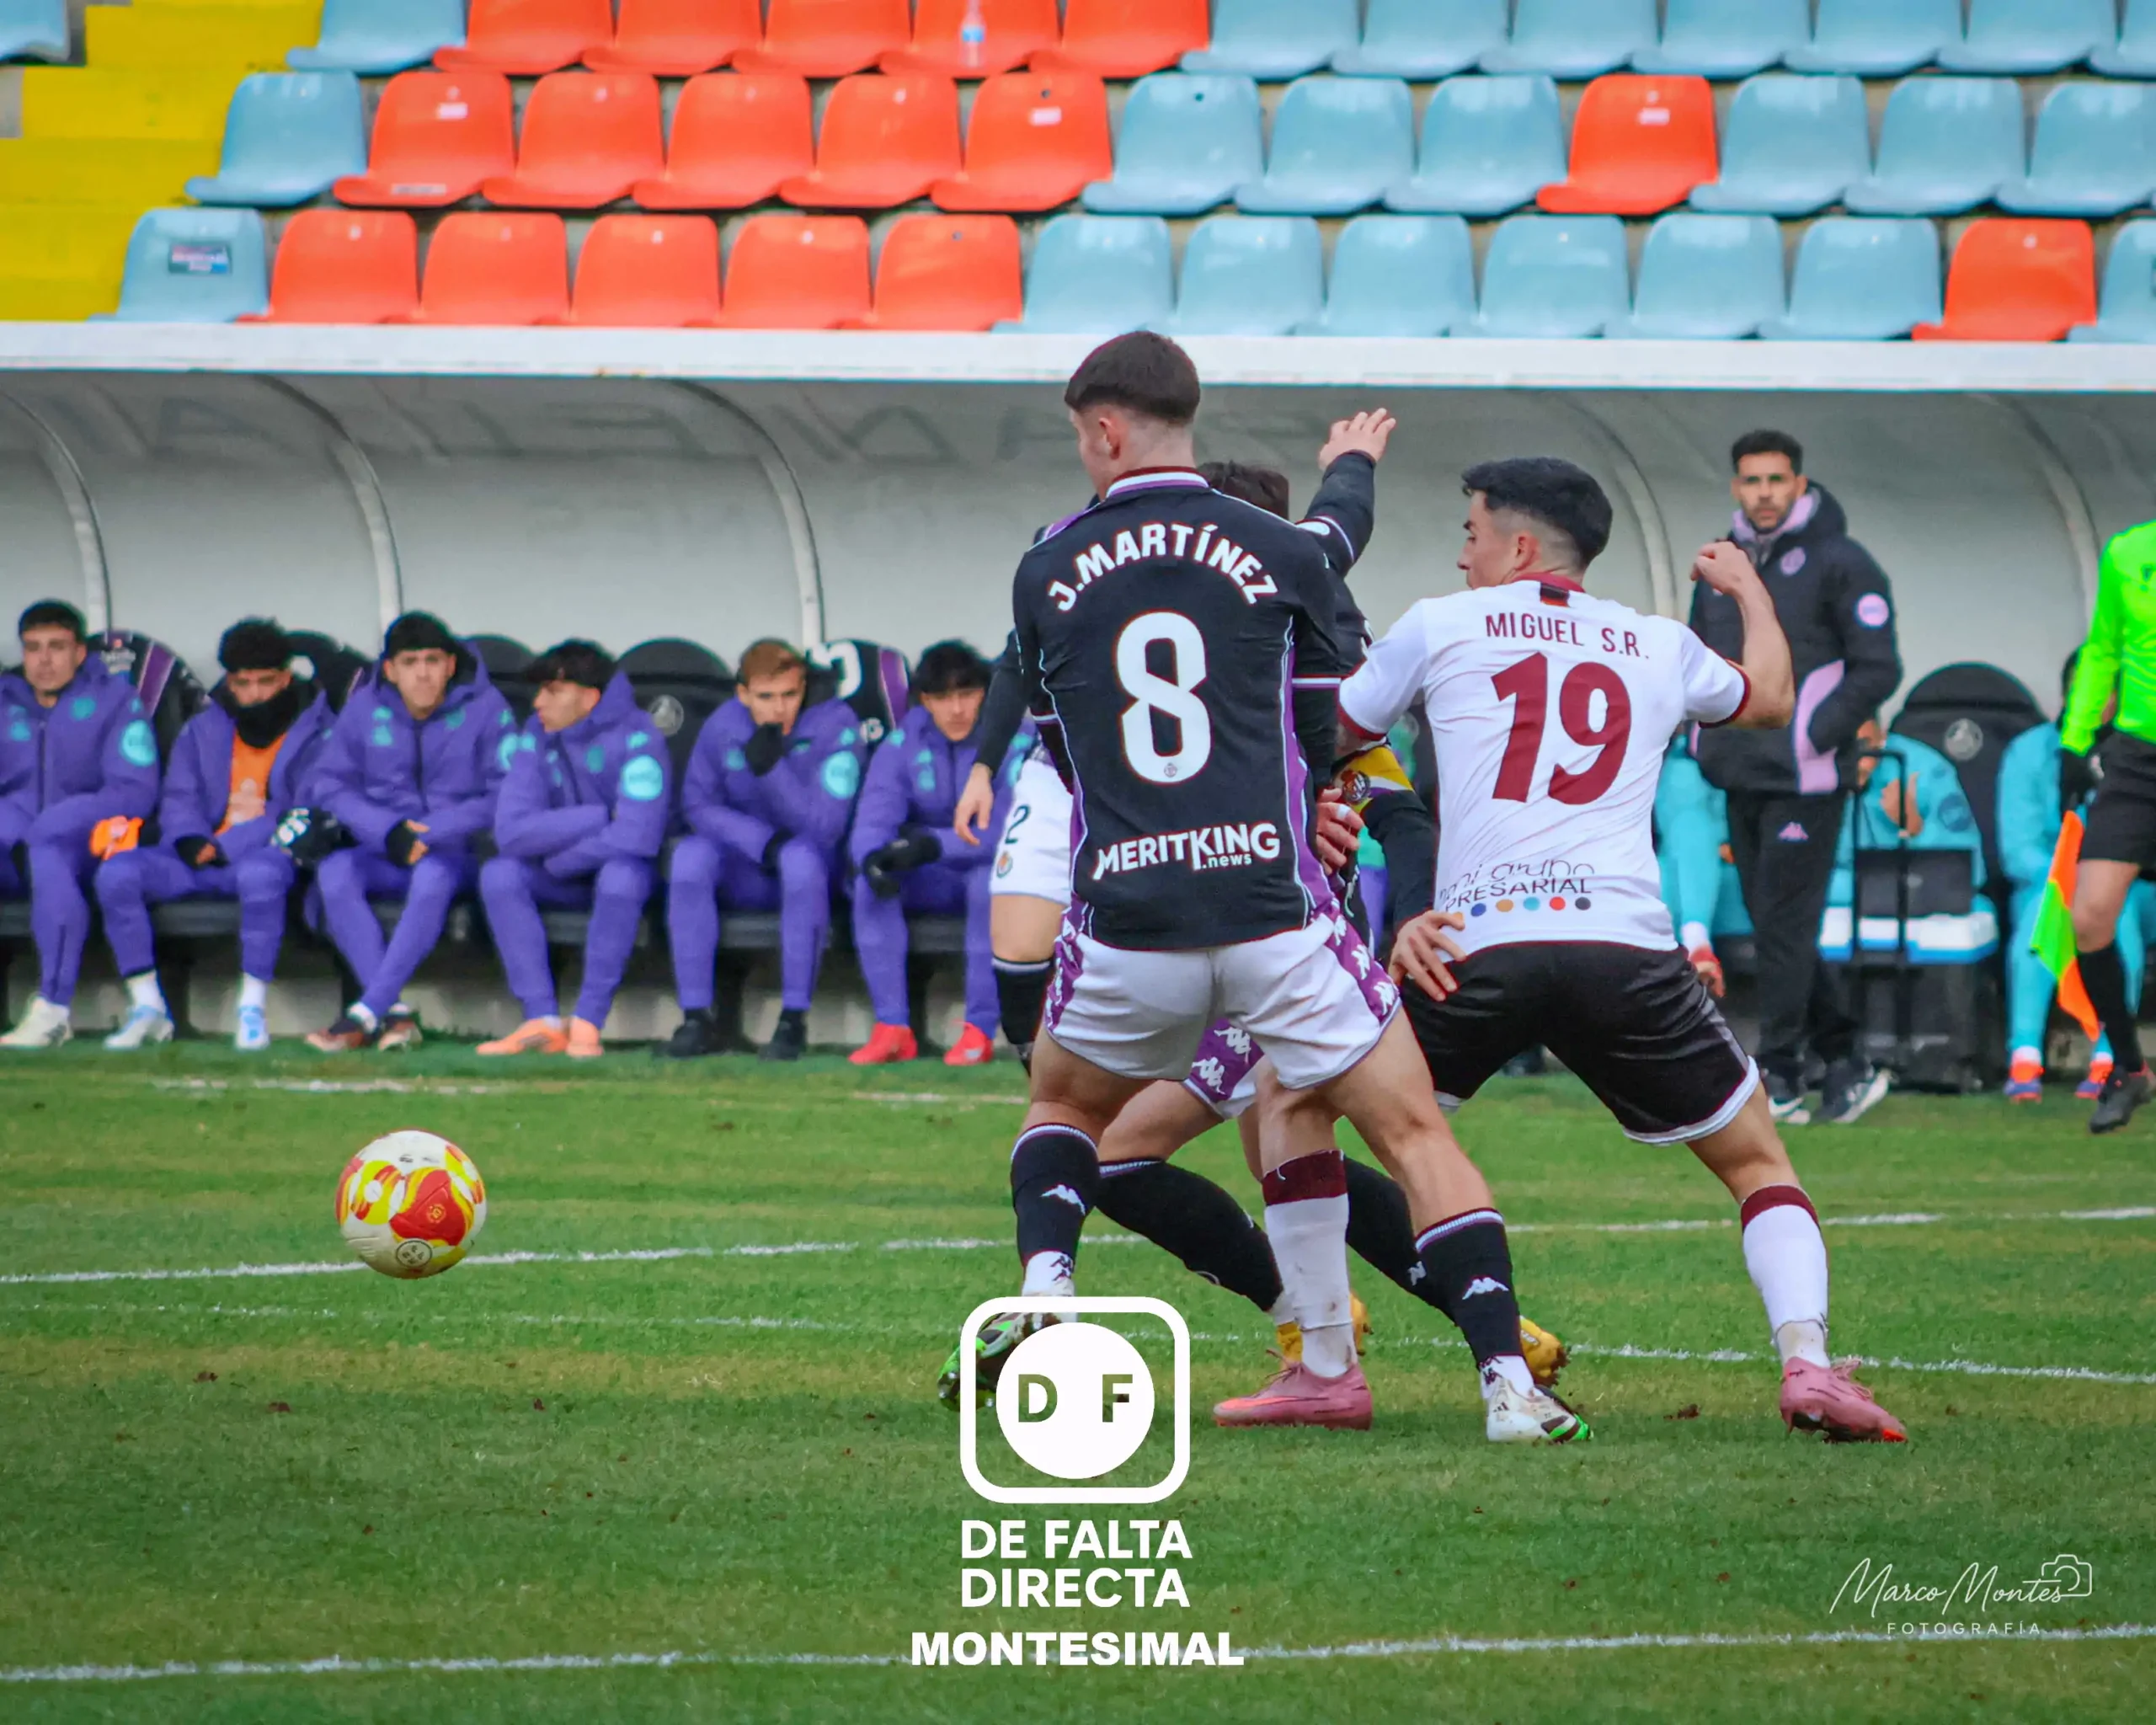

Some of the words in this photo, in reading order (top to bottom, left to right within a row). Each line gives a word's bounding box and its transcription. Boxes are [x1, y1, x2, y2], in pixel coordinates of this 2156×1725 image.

[1049, 523, 1278, 611] J.MARTÍNEZ
[1486, 613, 1585, 646] MIGUEL
[1601, 628, 1649, 659] S.R.
[1116, 612, 1212, 783] 8
[1491, 653, 1631, 805] 19
[1005, 804, 1031, 844] 2
[1092, 822, 1280, 880] MERITKING
